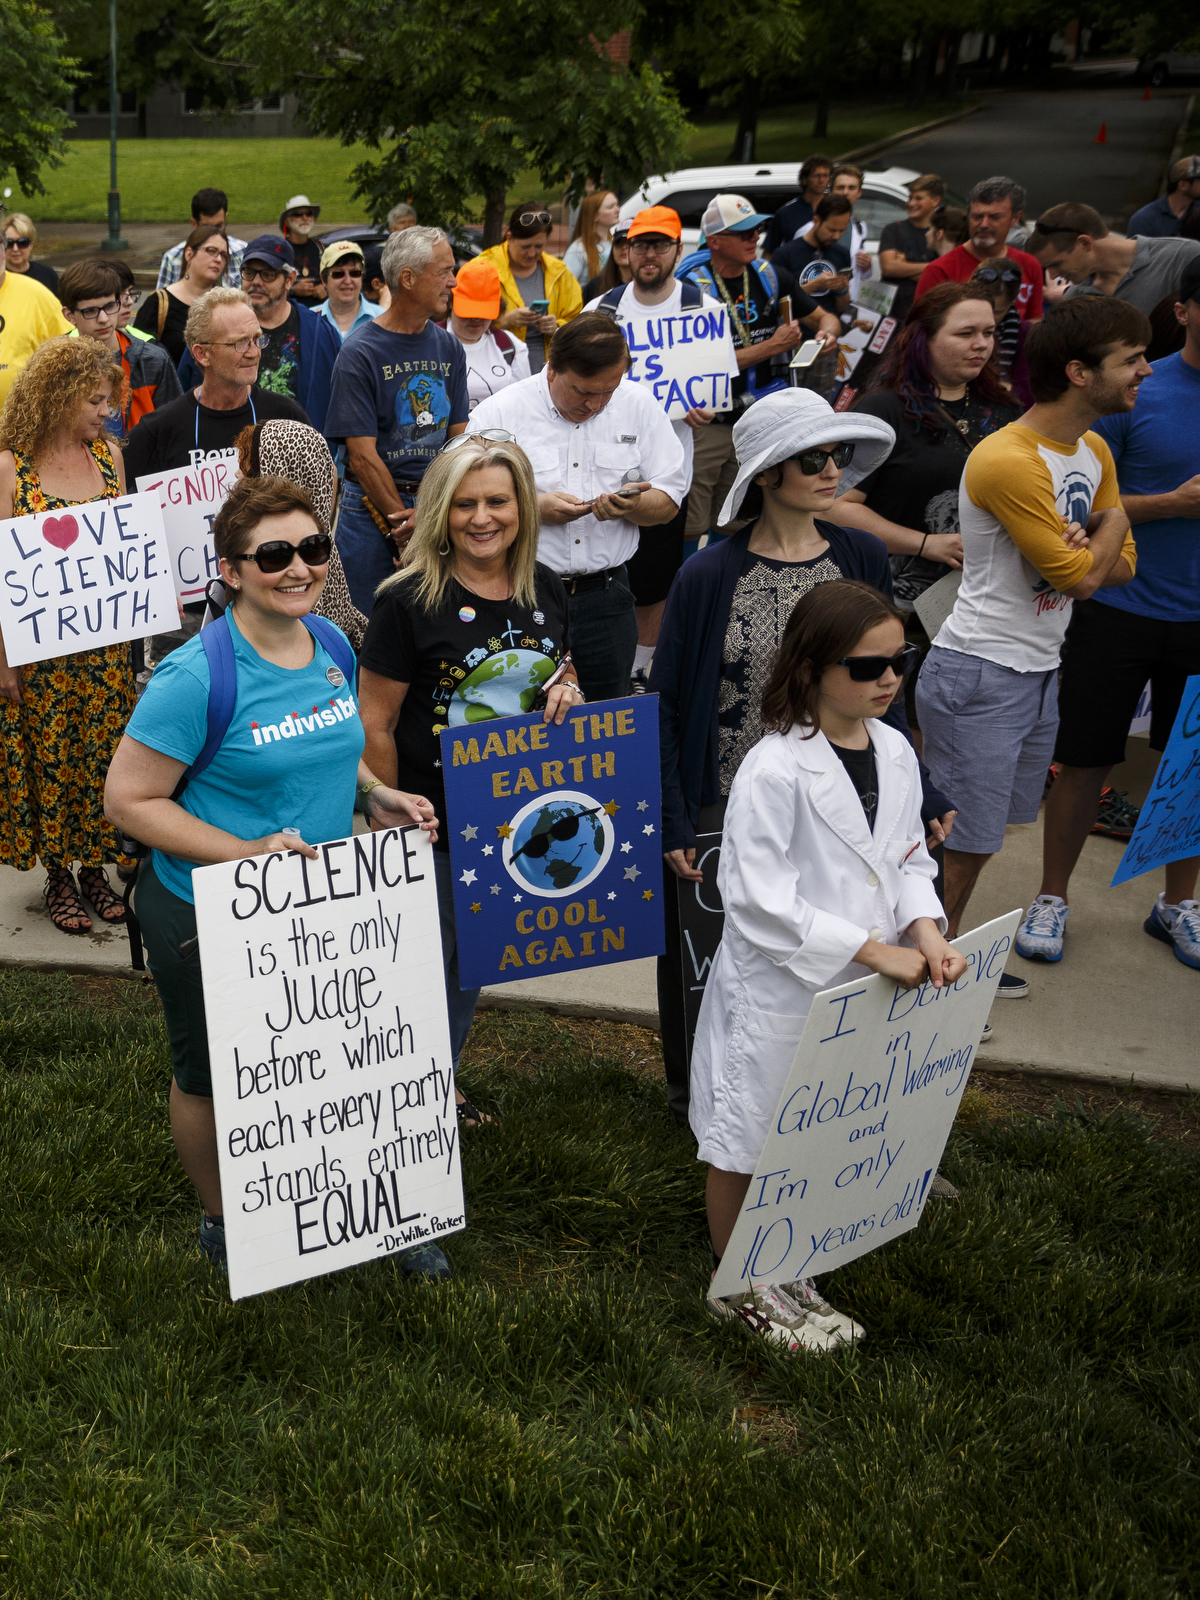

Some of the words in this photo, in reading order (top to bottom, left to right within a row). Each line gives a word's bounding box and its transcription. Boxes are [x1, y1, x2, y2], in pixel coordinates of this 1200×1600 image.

[626, 354, 664, 382] IS
[653, 373, 730, 414] FACT!
[4, 540, 168, 607] SCIENCE.
[18, 588, 158, 644] TRUTH.
[451, 722, 550, 767] MAKE
[569, 708, 636, 743] THE
[491, 751, 616, 798] EARTH
[1138, 790, 1184, 831] IS
[231, 824, 425, 920] SCIENCE
[245, 940, 277, 978] is
[287, 917, 339, 967] the
[350, 899, 401, 963] only
[515, 899, 606, 935] COOL
[498, 926, 626, 971] AGAIN
[819, 989, 867, 1043] I
[885, 1030, 911, 1055] in
[233, 1034, 327, 1100] before
[341, 1005, 415, 1071] which
[228, 1100, 295, 1158] each
[319, 1089, 382, 1139] every
[391, 1057, 452, 1132] party
[777, 1056, 897, 1135] Global
[902, 1032, 973, 1097] Warming
[848, 1110, 889, 1143] and
[241, 1145, 347, 1213] stands
[367, 1115, 457, 1178] entirely
[745, 1168, 808, 1211] I'm
[834, 1138, 905, 1189] only
[294, 1170, 428, 1256] EQUAL.
[400, 1225, 431, 1244] Willie
[430, 1214, 465, 1234] Parker
[740, 1216, 794, 1280] 10
[794, 1213, 876, 1279] years
[880, 1167, 933, 1228] old!
